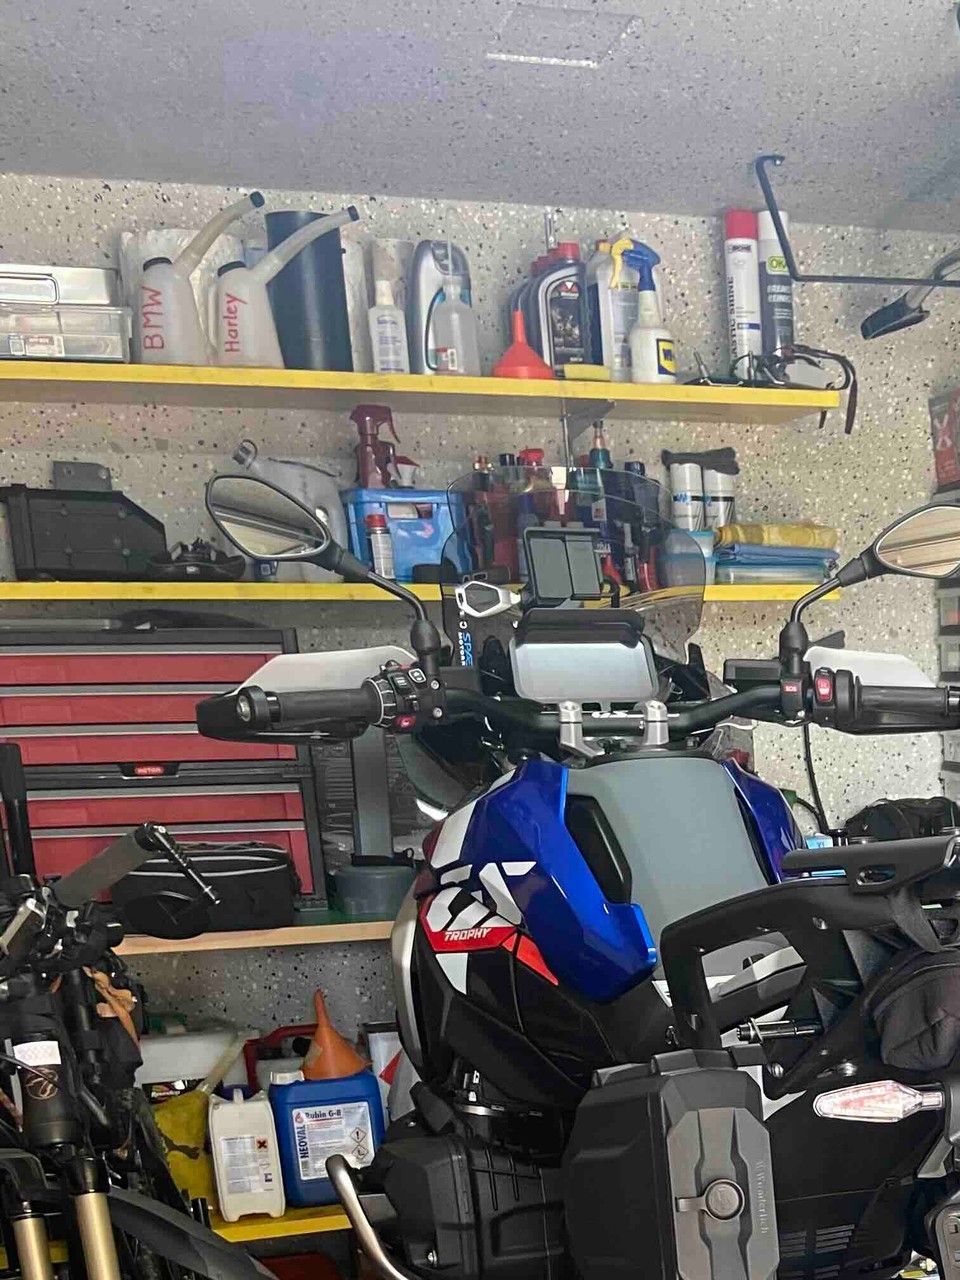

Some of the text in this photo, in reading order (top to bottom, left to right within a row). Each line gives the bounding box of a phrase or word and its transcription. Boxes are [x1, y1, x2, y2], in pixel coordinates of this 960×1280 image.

[140, 286, 165, 352] BMW
[223, 292, 249, 354] Harley
[444, 928, 492, 942] TROPHY
